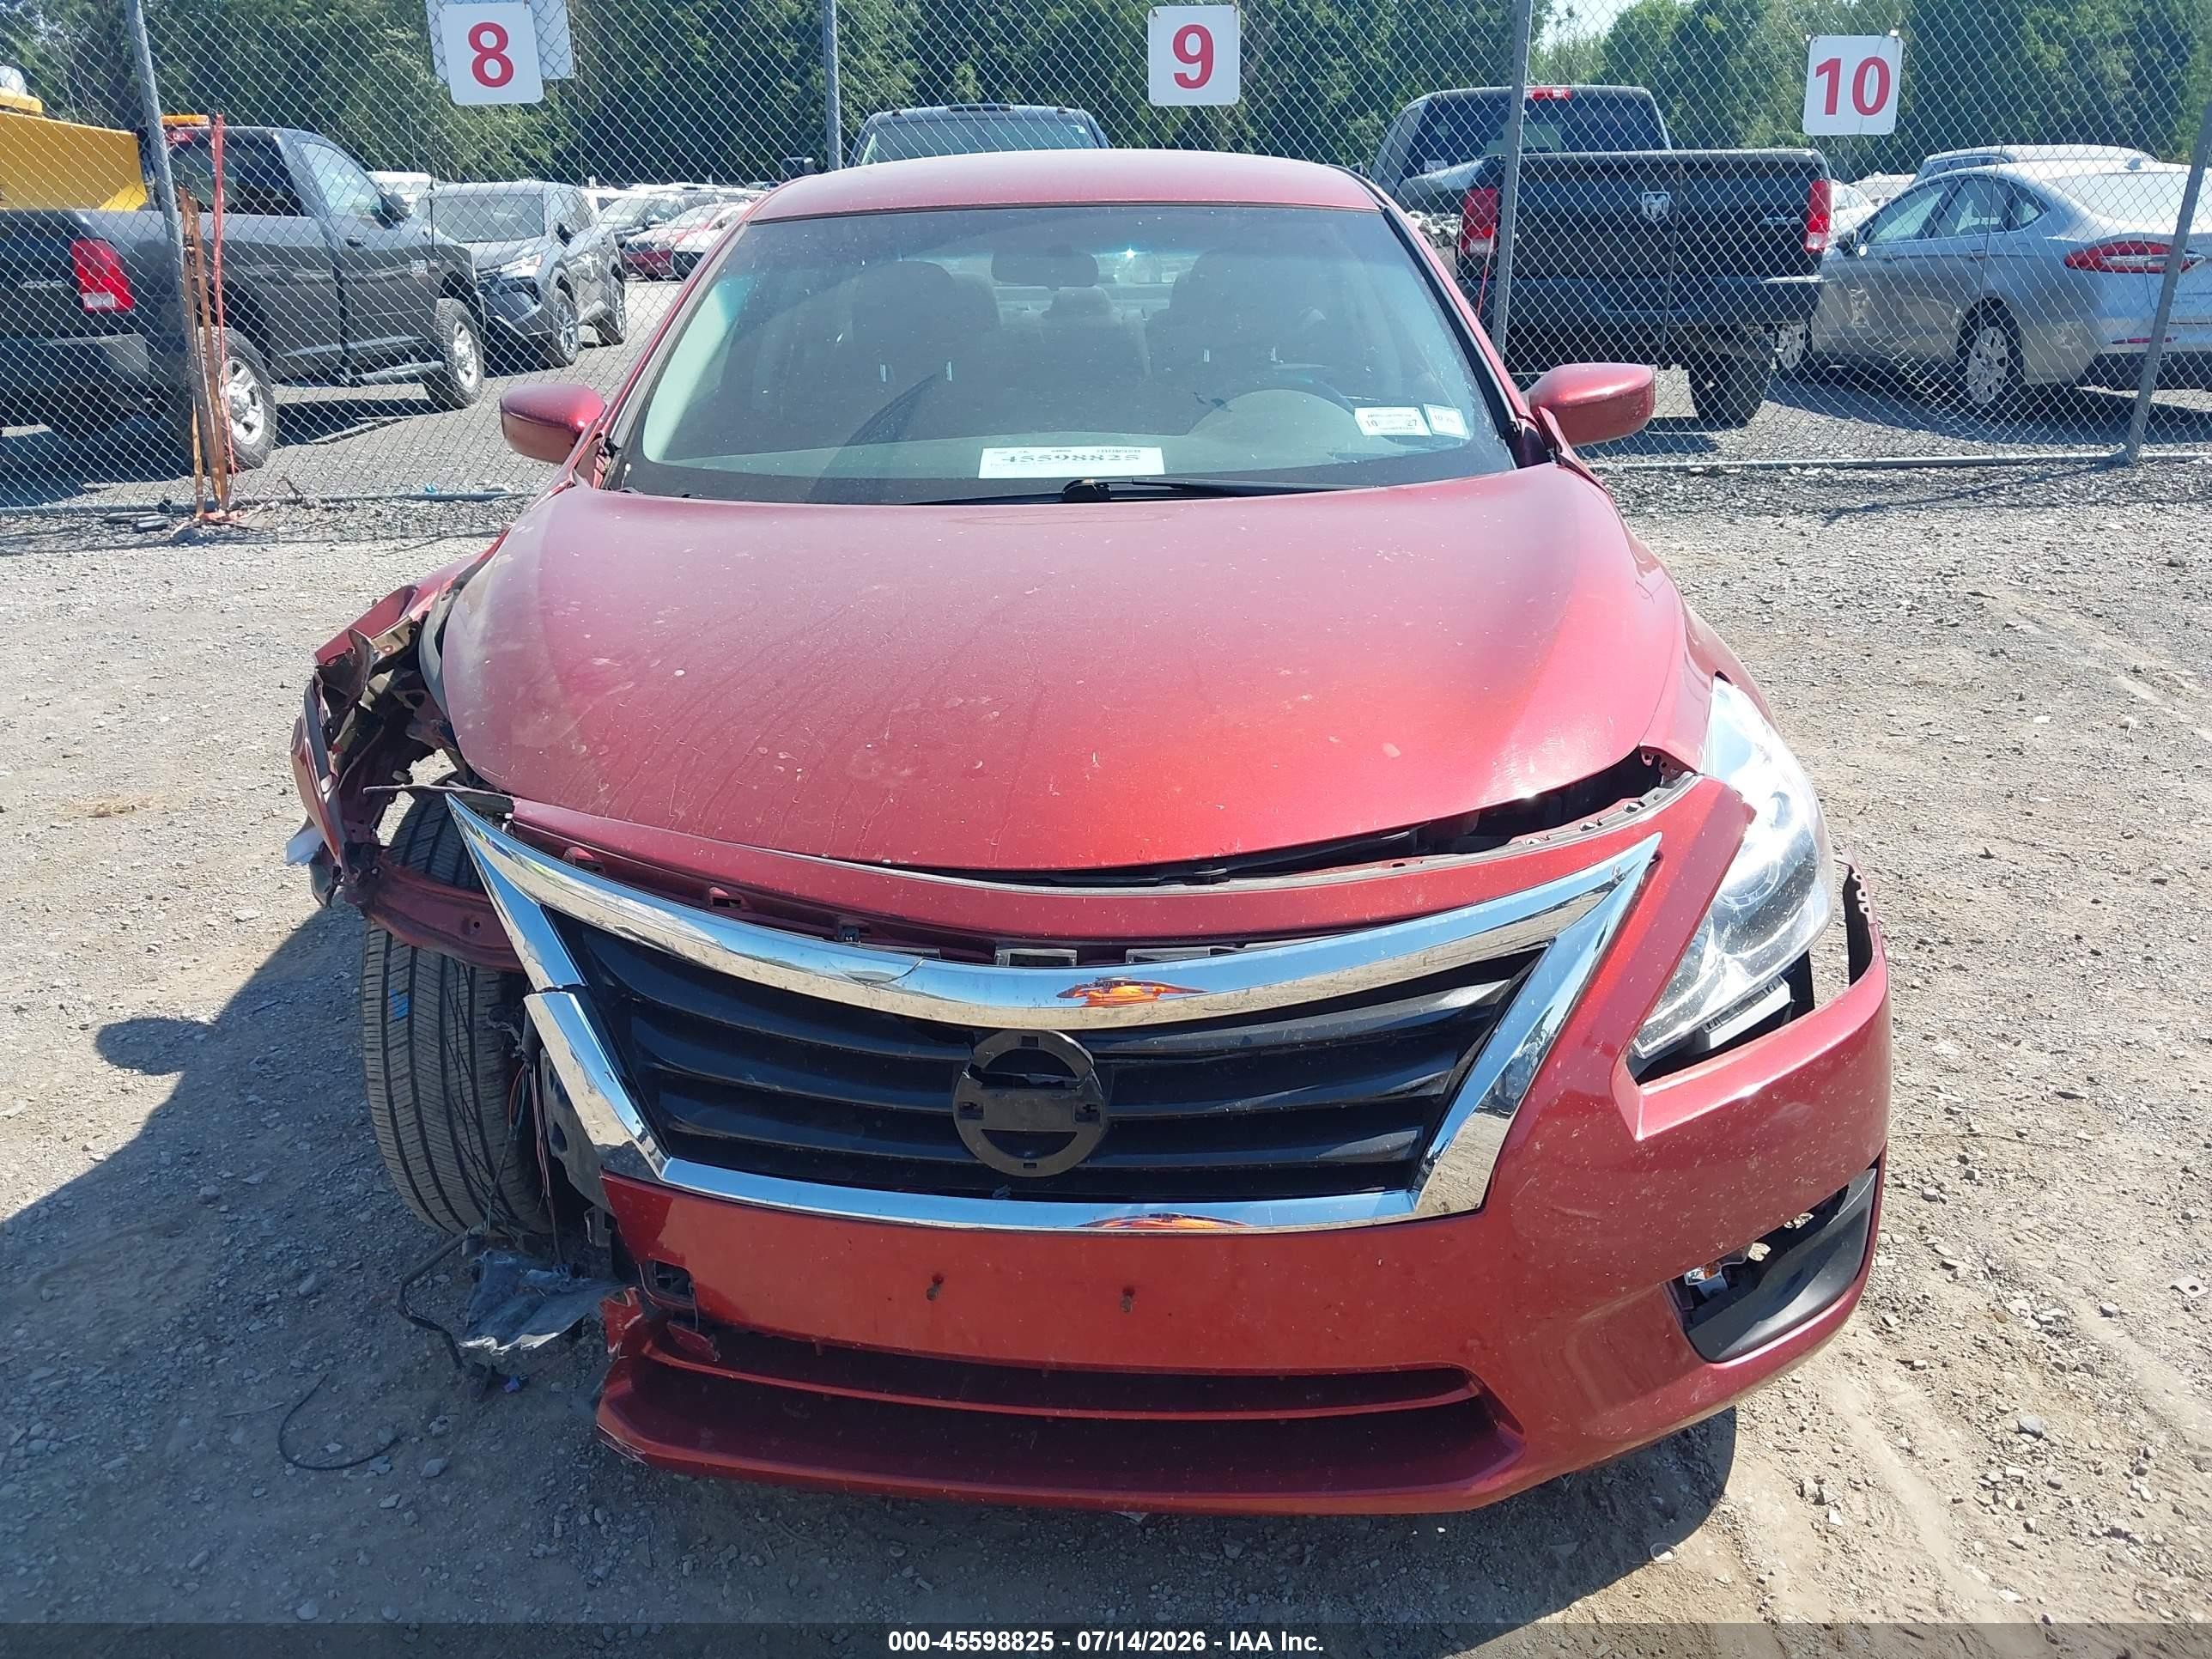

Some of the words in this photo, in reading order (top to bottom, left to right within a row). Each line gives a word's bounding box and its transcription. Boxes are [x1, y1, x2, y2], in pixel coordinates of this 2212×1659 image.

[469, 22, 514, 88] 8
[1173, 24, 1213, 89] 9
[1815, 57, 1891, 116] 10
[1001, 454, 1140, 463] 45598825
